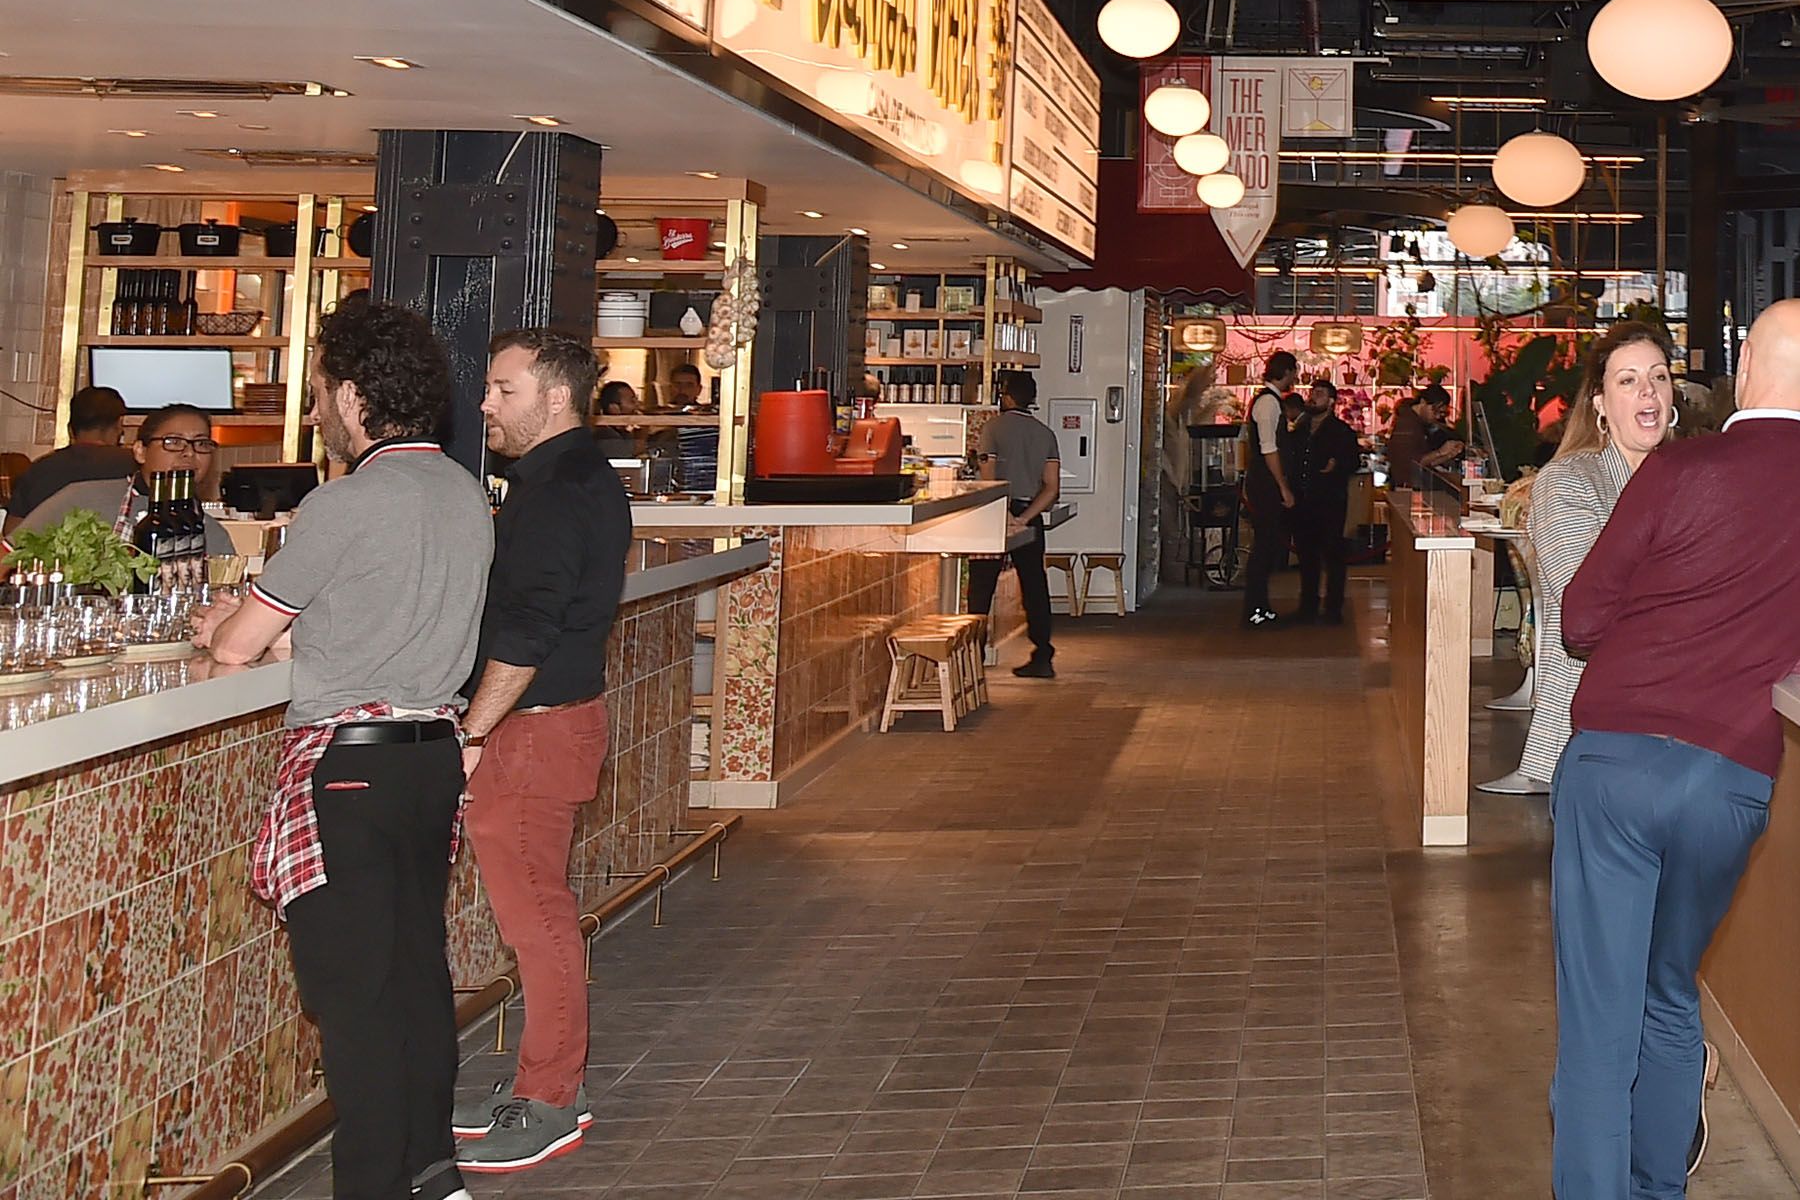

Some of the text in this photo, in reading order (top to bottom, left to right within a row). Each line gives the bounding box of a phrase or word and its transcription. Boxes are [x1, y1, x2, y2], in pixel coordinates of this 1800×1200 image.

[1230, 78, 1264, 113] THE
[1226, 116, 1265, 151] MER
[1227, 153, 1269, 189] ADO
